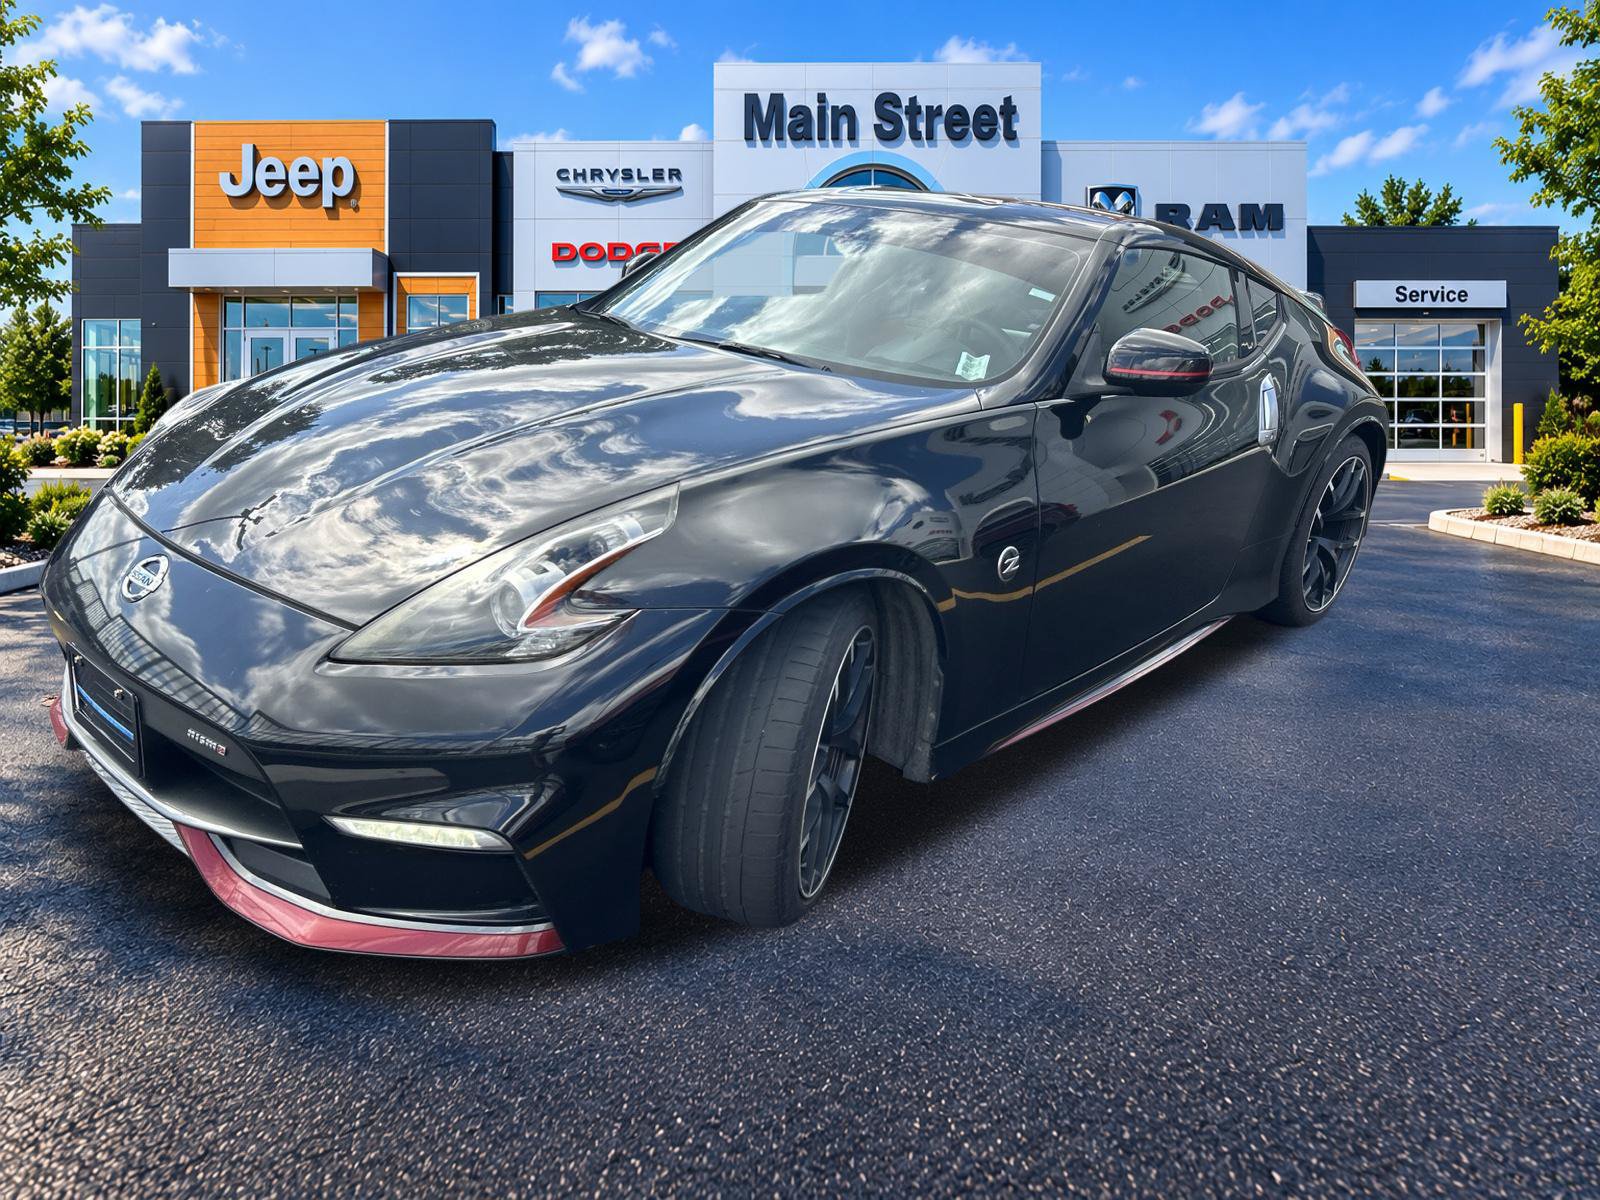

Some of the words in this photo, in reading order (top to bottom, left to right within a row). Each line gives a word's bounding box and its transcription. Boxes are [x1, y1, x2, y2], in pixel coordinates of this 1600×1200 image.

[744, 92, 856, 141] Main
[873, 91, 1017, 141] Street
[218, 143, 354, 208] Jeep
[556, 168, 682, 183] CHRYSLER
[1155, 203, 1283, 231] RAM
[1395, 285, 1469, 303] Service
